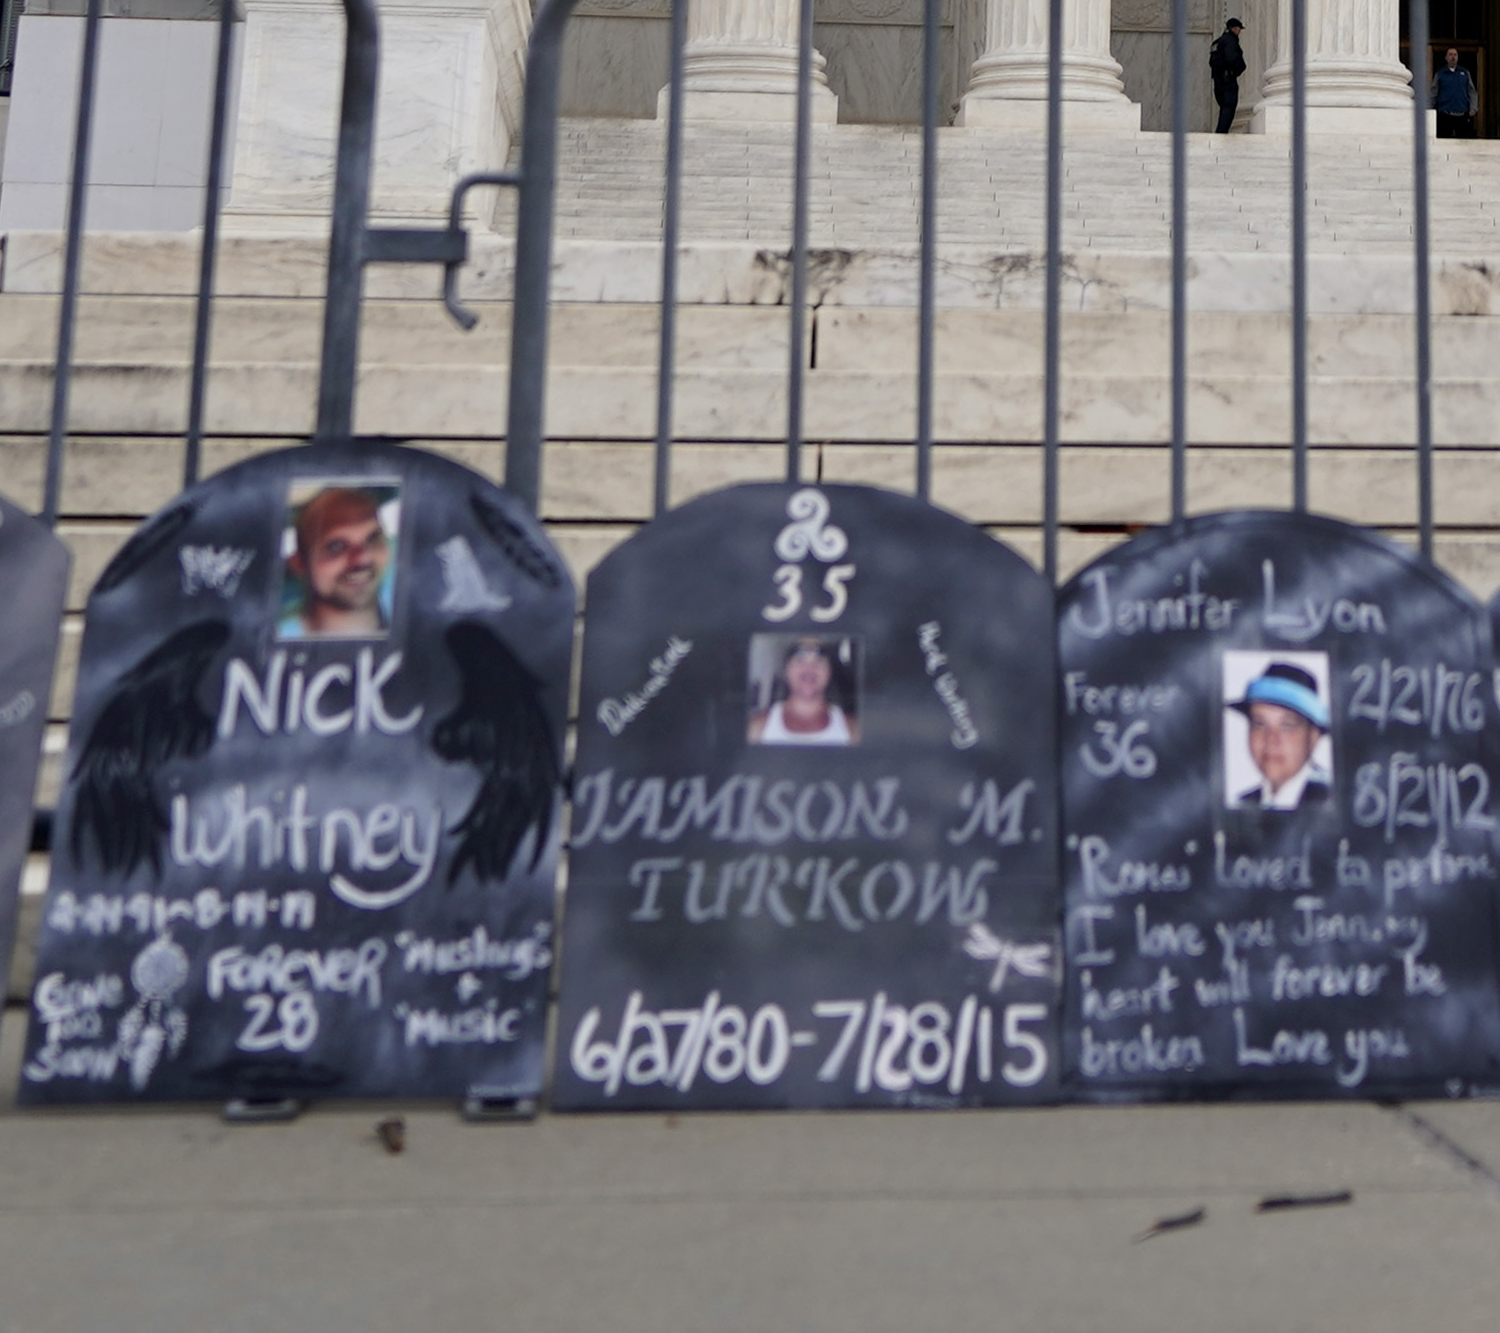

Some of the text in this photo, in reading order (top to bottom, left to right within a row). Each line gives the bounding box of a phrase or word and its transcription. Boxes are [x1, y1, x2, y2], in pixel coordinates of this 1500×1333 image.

[763, 563, 856, 623] 35
[1067, 559, 1387, 643] Jennifer Lyon
[1064, 672, 1181, 717] Forever
[1079, 720, 1157, 778] 36
[572, 769, 1043, 851] JAMISON M.
[628, 855, 998, 932] TURKOW
[1074, 904, 1115, 966] I
[1136, 903, 1206, 957] love
[1272, 953, 1388, 1002] forever
[236, 992, 319, 1052] 28
[1233, 1006, 1331, 1067] Love
